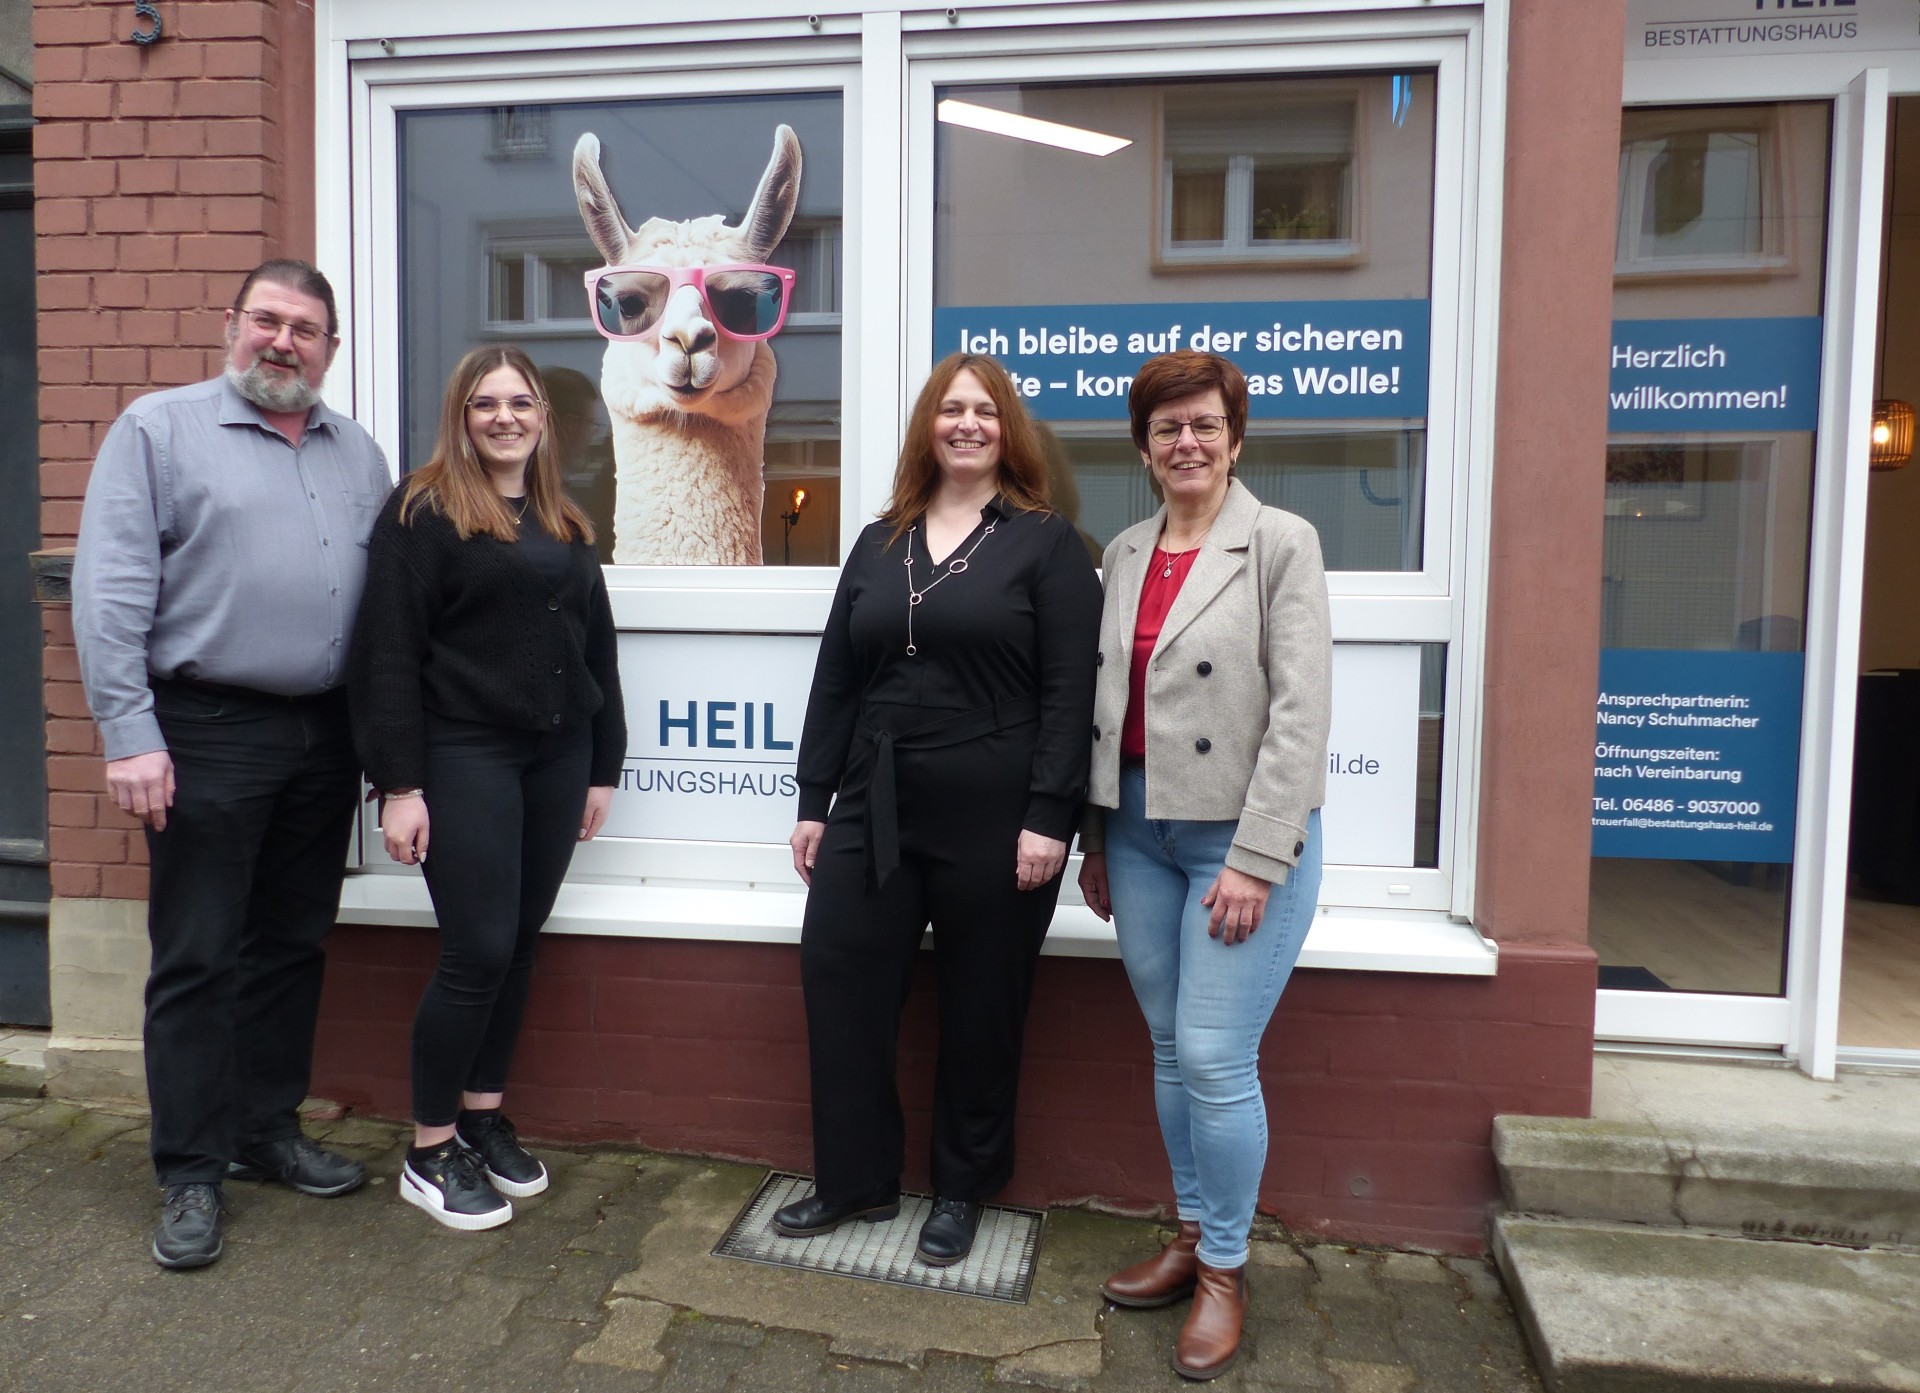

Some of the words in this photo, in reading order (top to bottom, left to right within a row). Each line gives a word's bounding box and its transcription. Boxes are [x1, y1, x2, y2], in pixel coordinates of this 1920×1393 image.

[1644, 22, 1858, 48] BESTATTUNGSHAUS
[960, 328, 1009, 355] Ich
[1019, 326, 1118, 355] bleibe
[1127, 325, 1181, 354] auf
[1189, 325, 1247, 353] der
[1255, 322, 1403, 352] sicheren
[1611, 344, 1726, 369] Herzlich
[1243, 373, 1283, 396] as
[1292, 366, 1400, 395] Wolle!
[1609, 385, 1787, 410] willkommen!
[1596, 692, 1750, 709] Ansprechpartnerin:
[659, 699, 794, 751] HEIL
[1596, 711, 1645, 728] Nancy
[1648, 712, 1759, 728] Schuhmacher
[1594, 742, 1720, 762] Öffnungszeiten:
[1594, 765, 1632, 778] nach
[1636, 765, 1742, 783] Vereinbarung
[1592, 797, 1619, 811] Tel.
[1622, 798, 1674, 812] 06486
[1687, 800, 1760, 815] 9037000
[1591, 816, 1773, 832] trauerfall@bestattungshaus-heil.de
